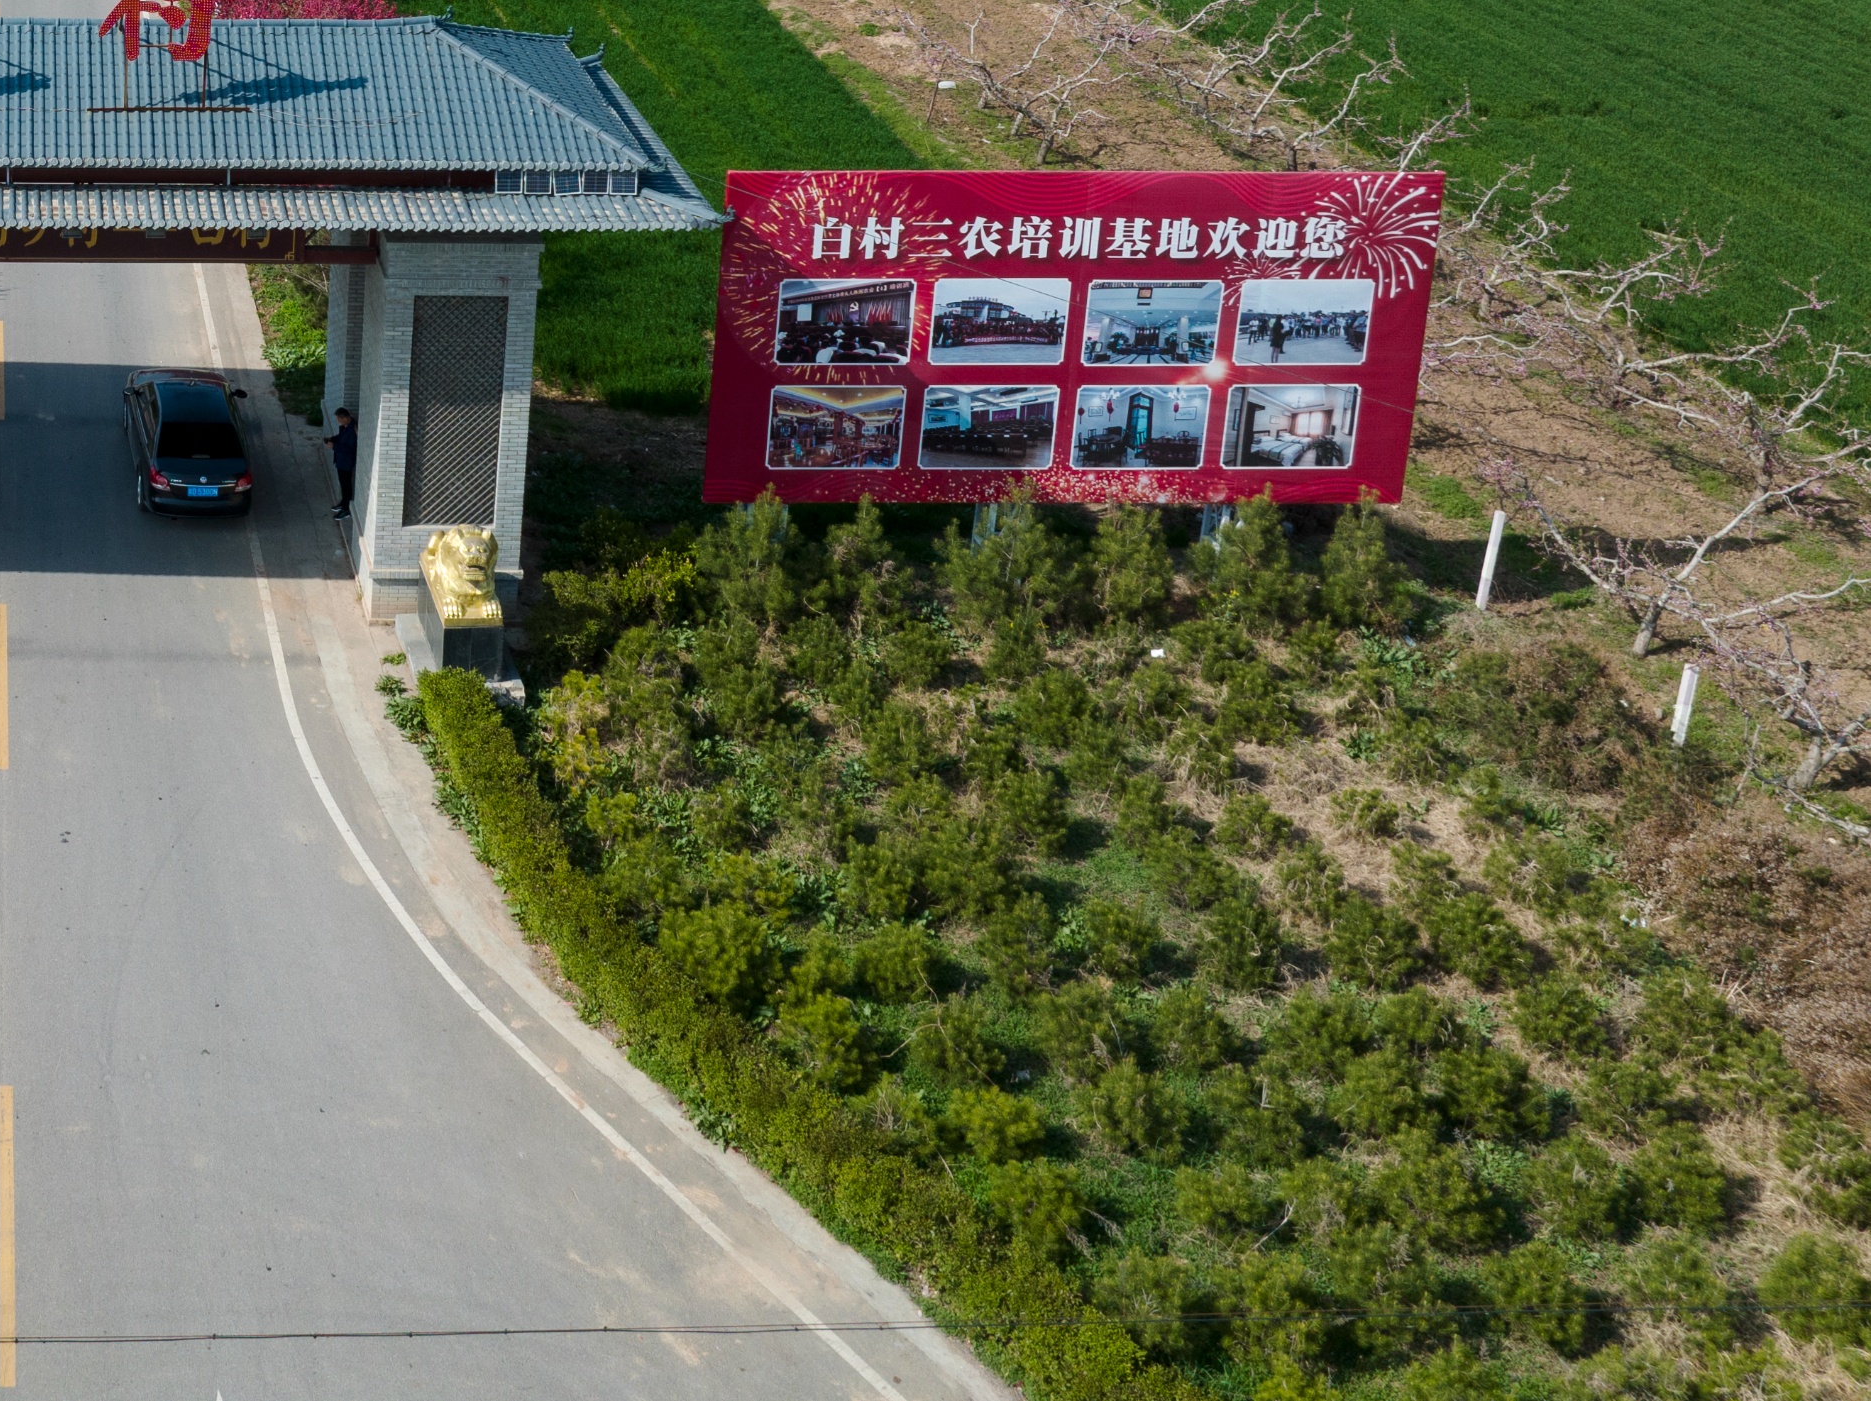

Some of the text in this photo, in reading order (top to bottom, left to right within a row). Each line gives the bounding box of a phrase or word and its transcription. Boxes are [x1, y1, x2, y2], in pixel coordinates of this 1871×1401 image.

[812, 216, 1346, 260] 白村三农培训基地欢迎您
